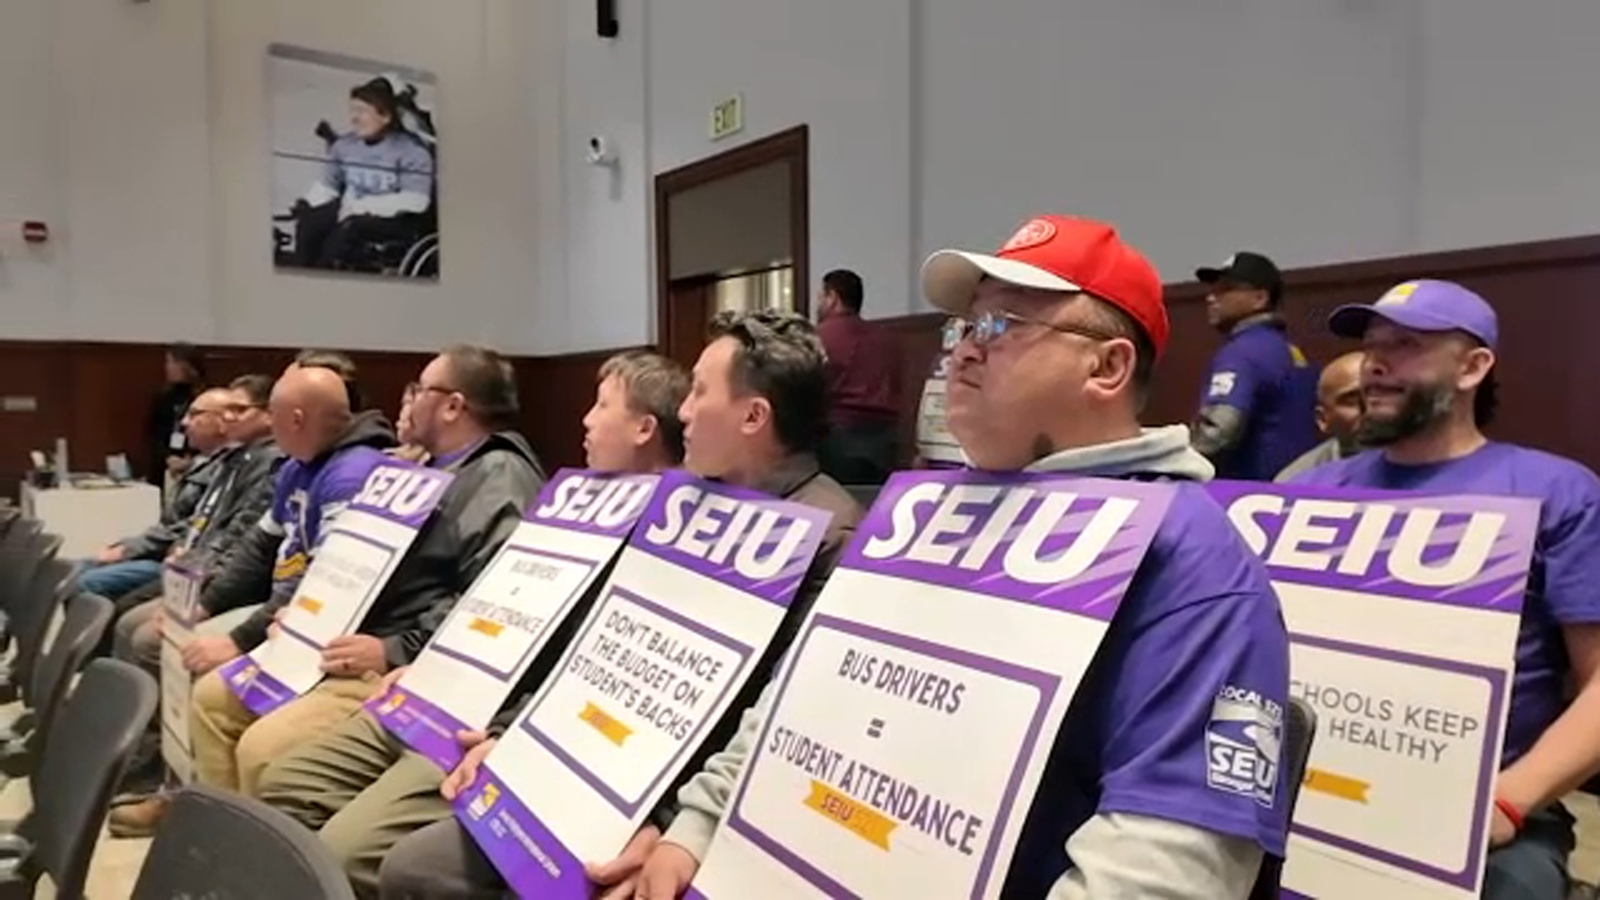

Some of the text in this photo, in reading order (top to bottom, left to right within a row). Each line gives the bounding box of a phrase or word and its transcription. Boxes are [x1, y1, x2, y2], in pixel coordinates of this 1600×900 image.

[714, 99, 737, 133] EXIT
[352, 466, 441, 516] SEIU
[535, 475, 652, 528] SEIU
[645, 484, 812, 580] SEIU
[861, 481, 1140, 584] SEIU
[1226, 493, 1506, 587] SEIU
[592, 633, 704, 709] THE BUDGET ON
[605, 610, 723, 682] DON'T BALANCE
[570, 653, 641, 709] STUDENT'S
[635, 694, 693, 742] BACKS
[838, 648, 966, 715] BUS DRIVERS
[1219, 684, 1262, 705] LOCAL
[1328, 715, 1448, 764] HEALTHY
[1403, 704, 1479, 739] KEEP
[769, 726, 983, 856] STUDENT ATTENDANCE
[819, 793, 854, 822] SEIU
